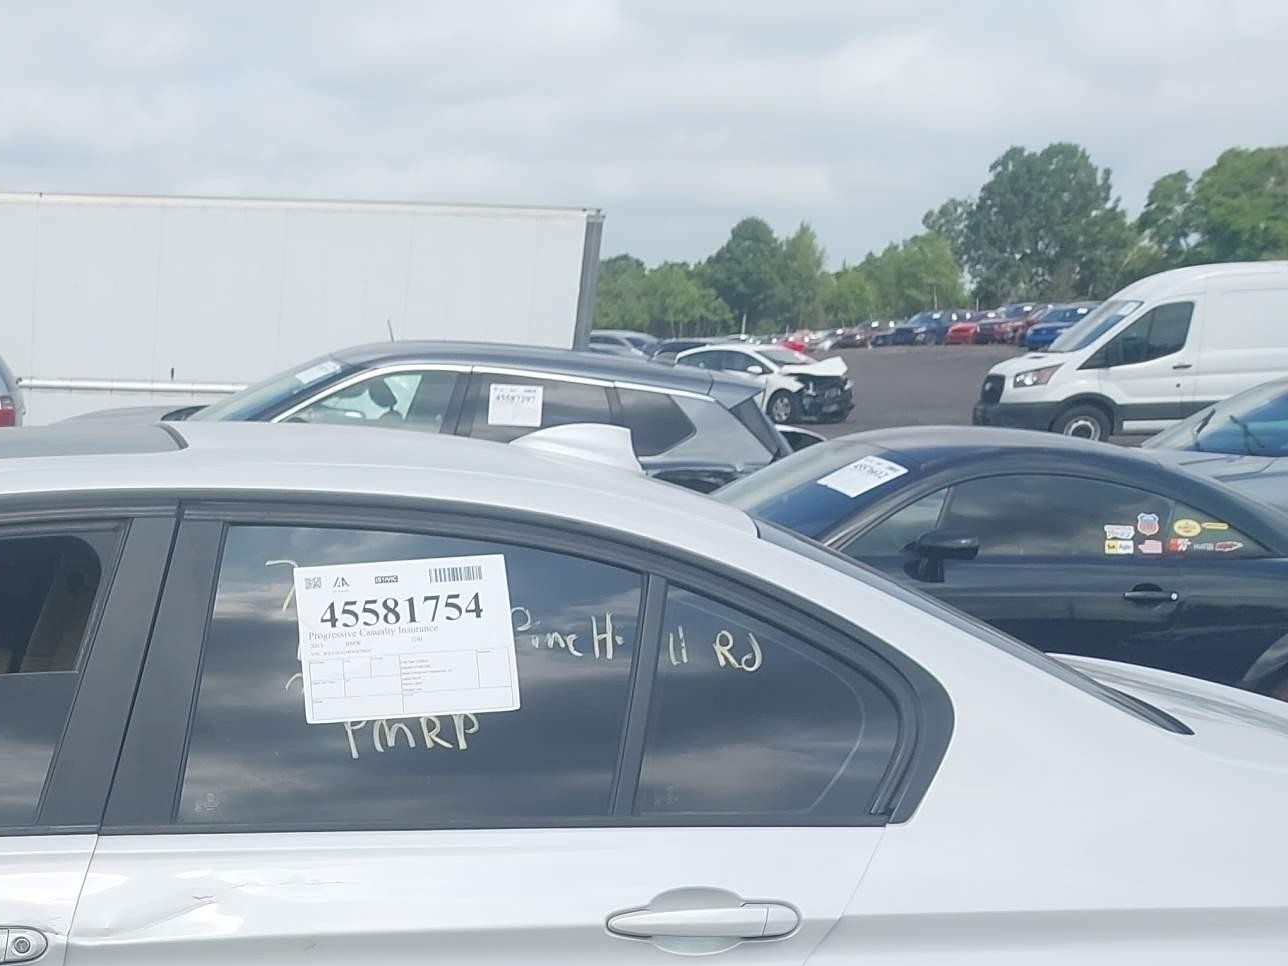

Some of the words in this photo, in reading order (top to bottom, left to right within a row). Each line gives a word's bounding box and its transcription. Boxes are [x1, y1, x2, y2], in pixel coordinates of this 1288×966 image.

[320, 591, 483, 628] 45581754
[308, 630, 358, 642] Progressive
[359, 627, 396, 638] Casualty
[398, 624, 439, 635] Insurance
